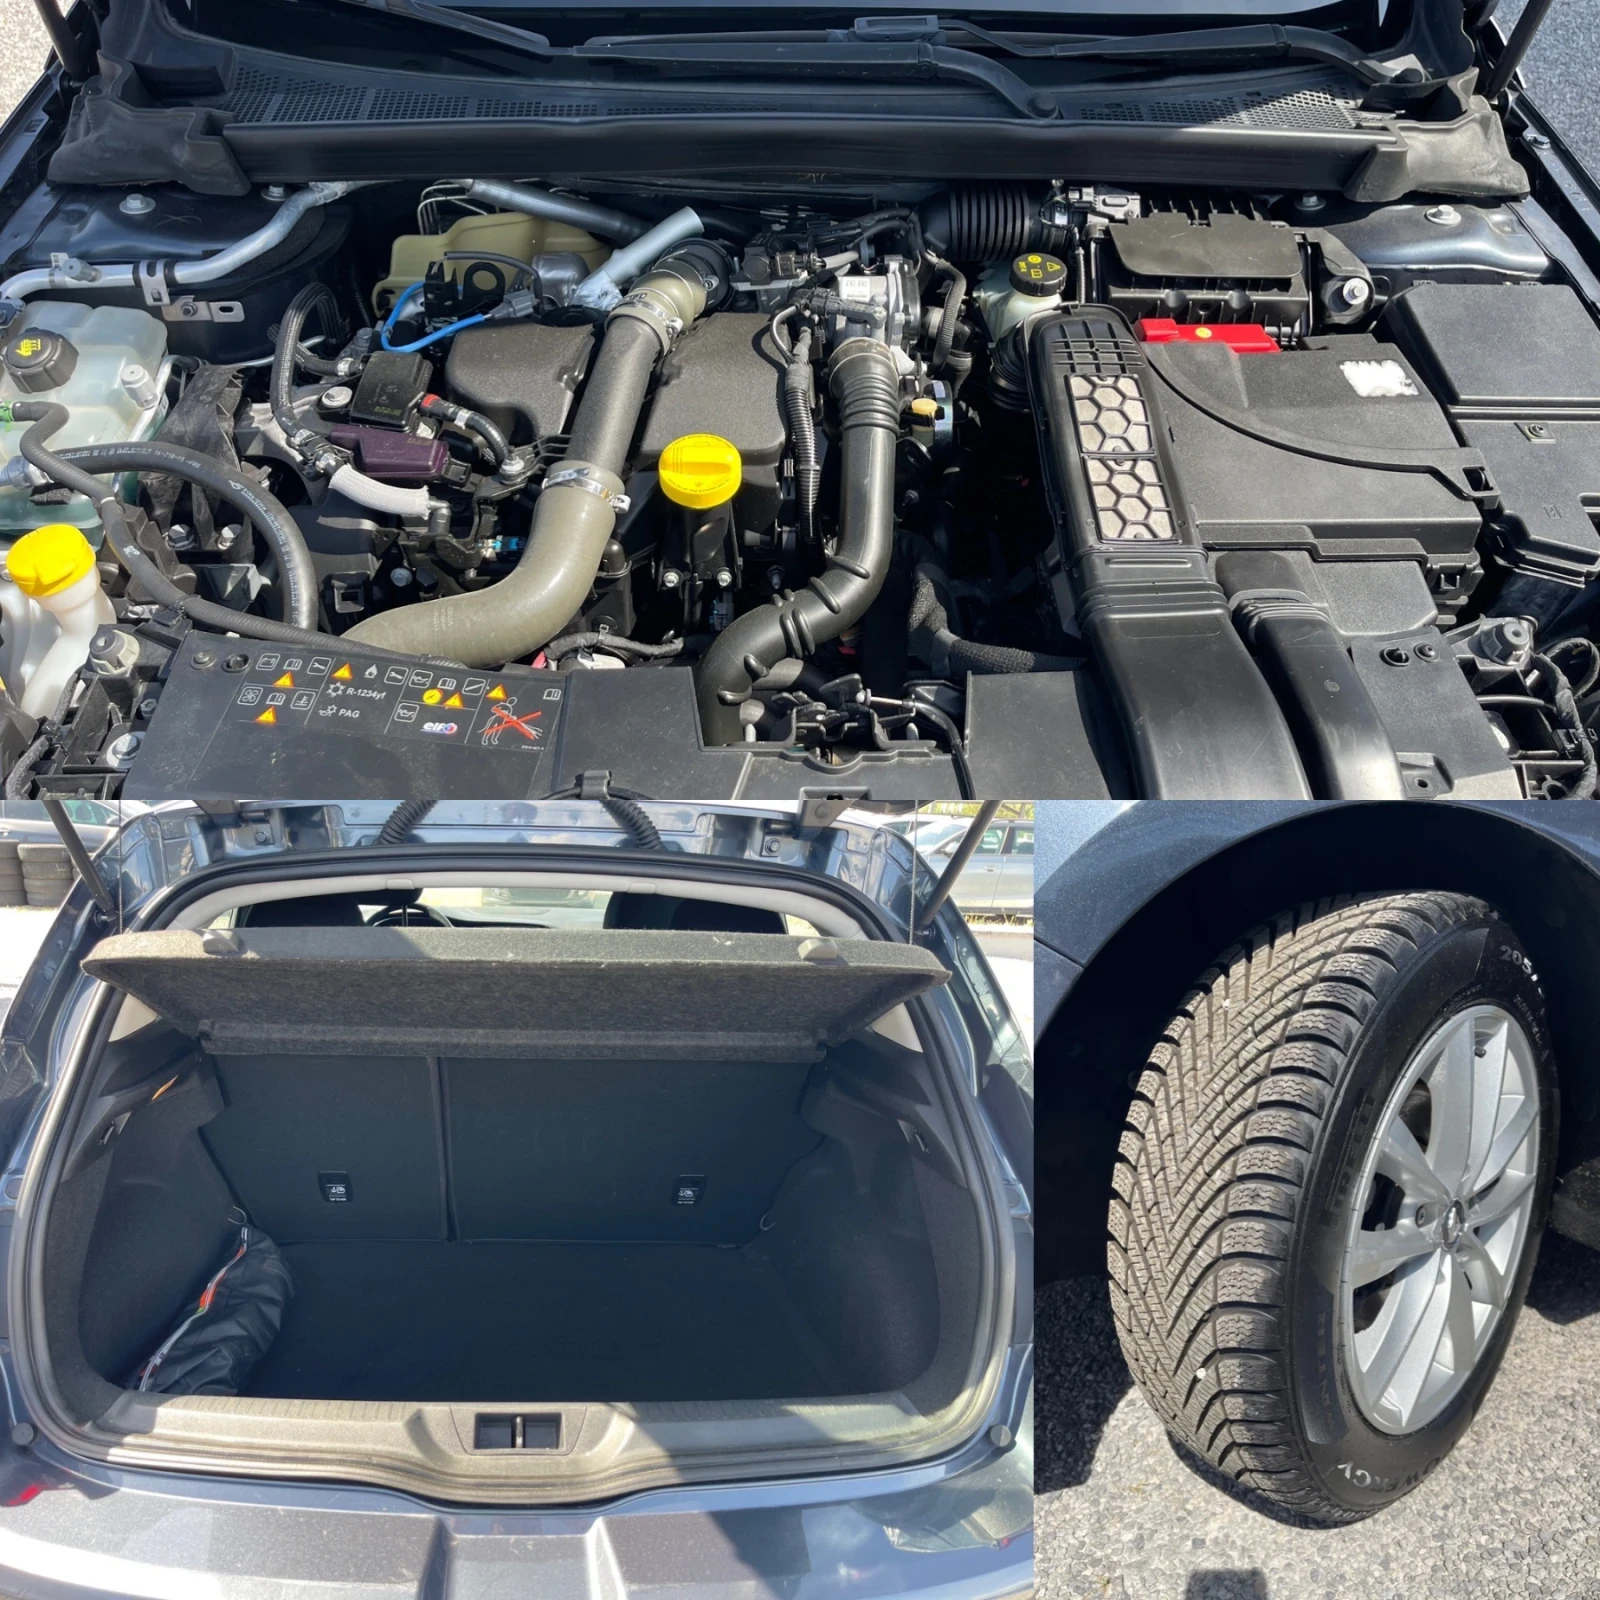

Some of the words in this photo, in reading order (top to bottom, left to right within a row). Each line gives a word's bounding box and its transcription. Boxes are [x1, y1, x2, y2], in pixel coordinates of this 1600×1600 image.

[345, 687, 387, 700] R-1234yf
[338, 708, 361, 718] PAG
[422, 721, 447, 733] elf
[1500, 945, 1533, 975] 205
[1337, 1455, 1441, 1494] OWERGY
